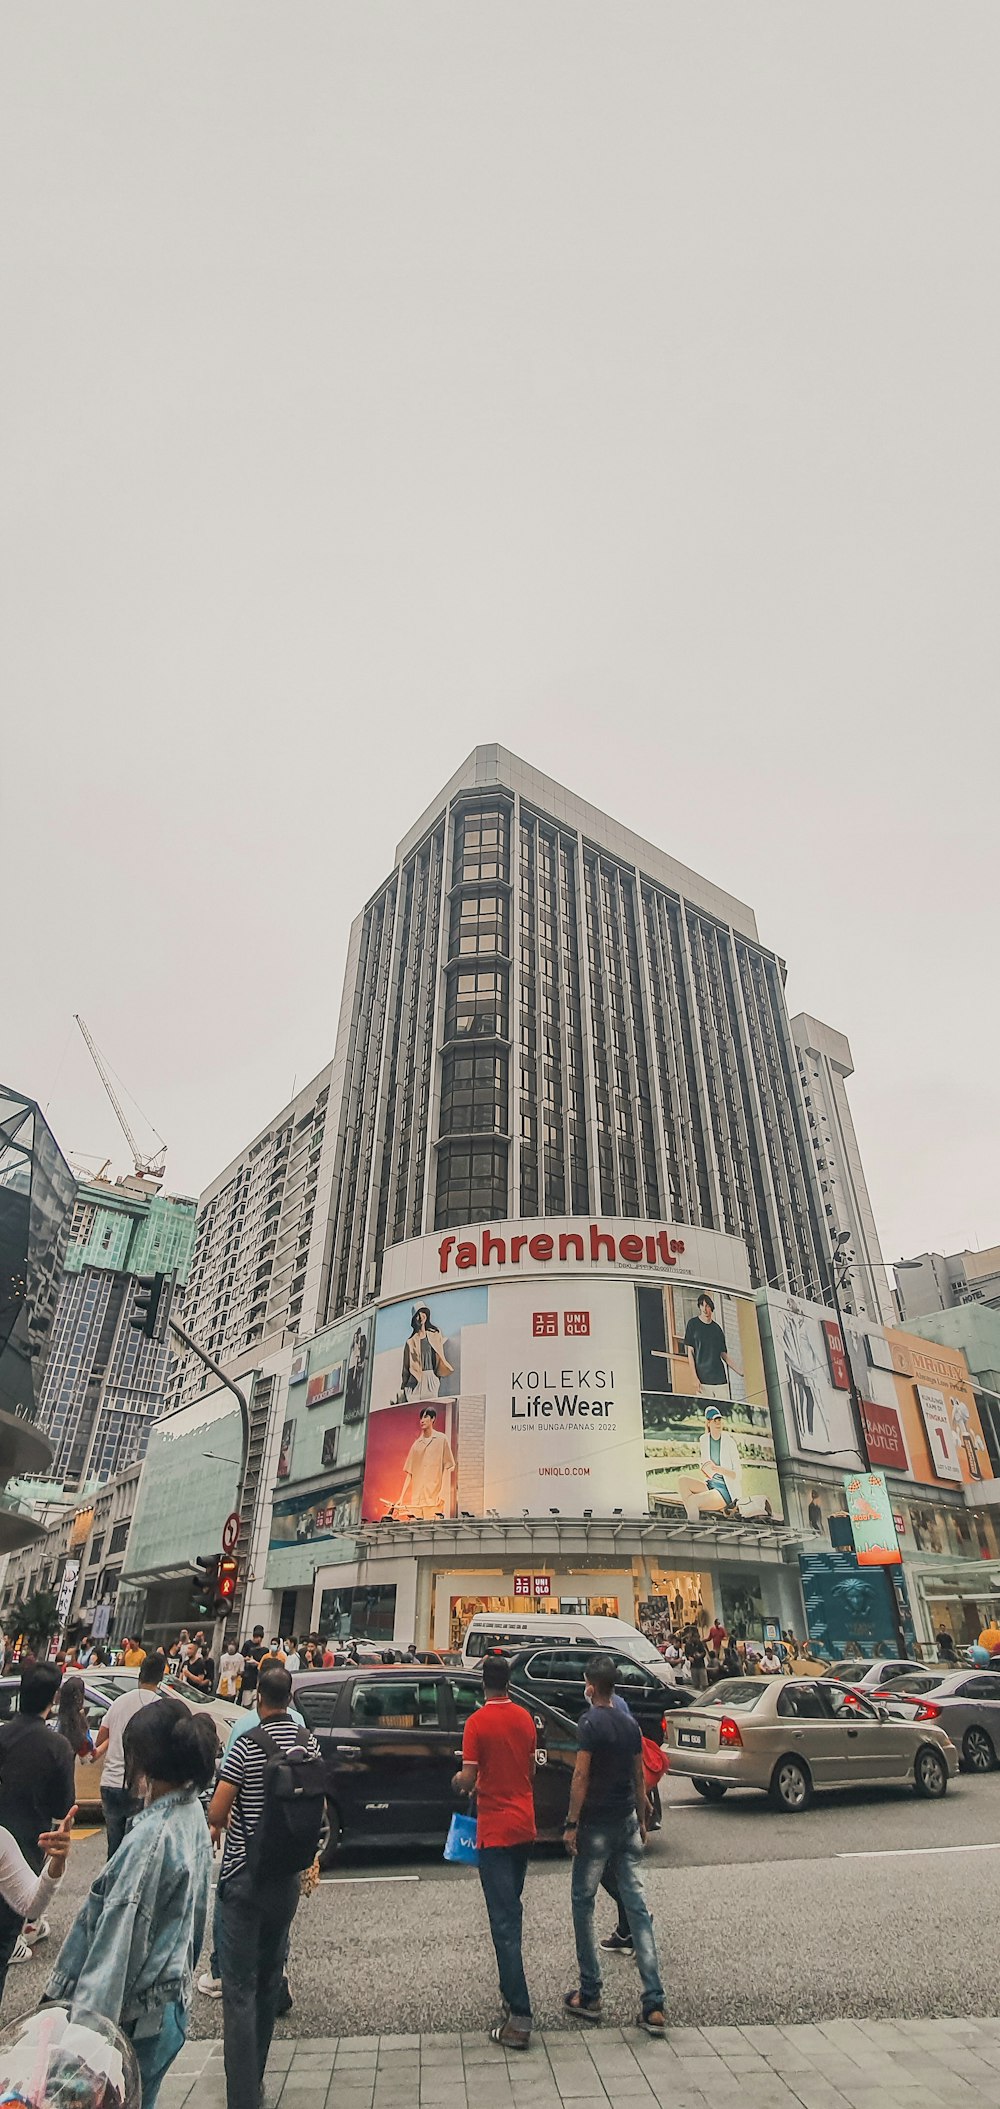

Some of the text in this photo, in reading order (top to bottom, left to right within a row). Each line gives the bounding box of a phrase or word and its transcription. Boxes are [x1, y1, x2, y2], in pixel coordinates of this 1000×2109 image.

[962, 1290, 986, 1305] HOTEL
[511, 1370, 614, 1390] KOLEKSI
[511, 1395, 614, 1418] LifeWear
[538, 1423, 595, 1431] BUNGA/PANAS
[598, 1423, 617, 1431] 2022
[865, 1432, 899, 1452] OUTLET
[934, 1427, 949, 1459] 1
[538, 1467, 591, 1477] UNIQLO.COM
